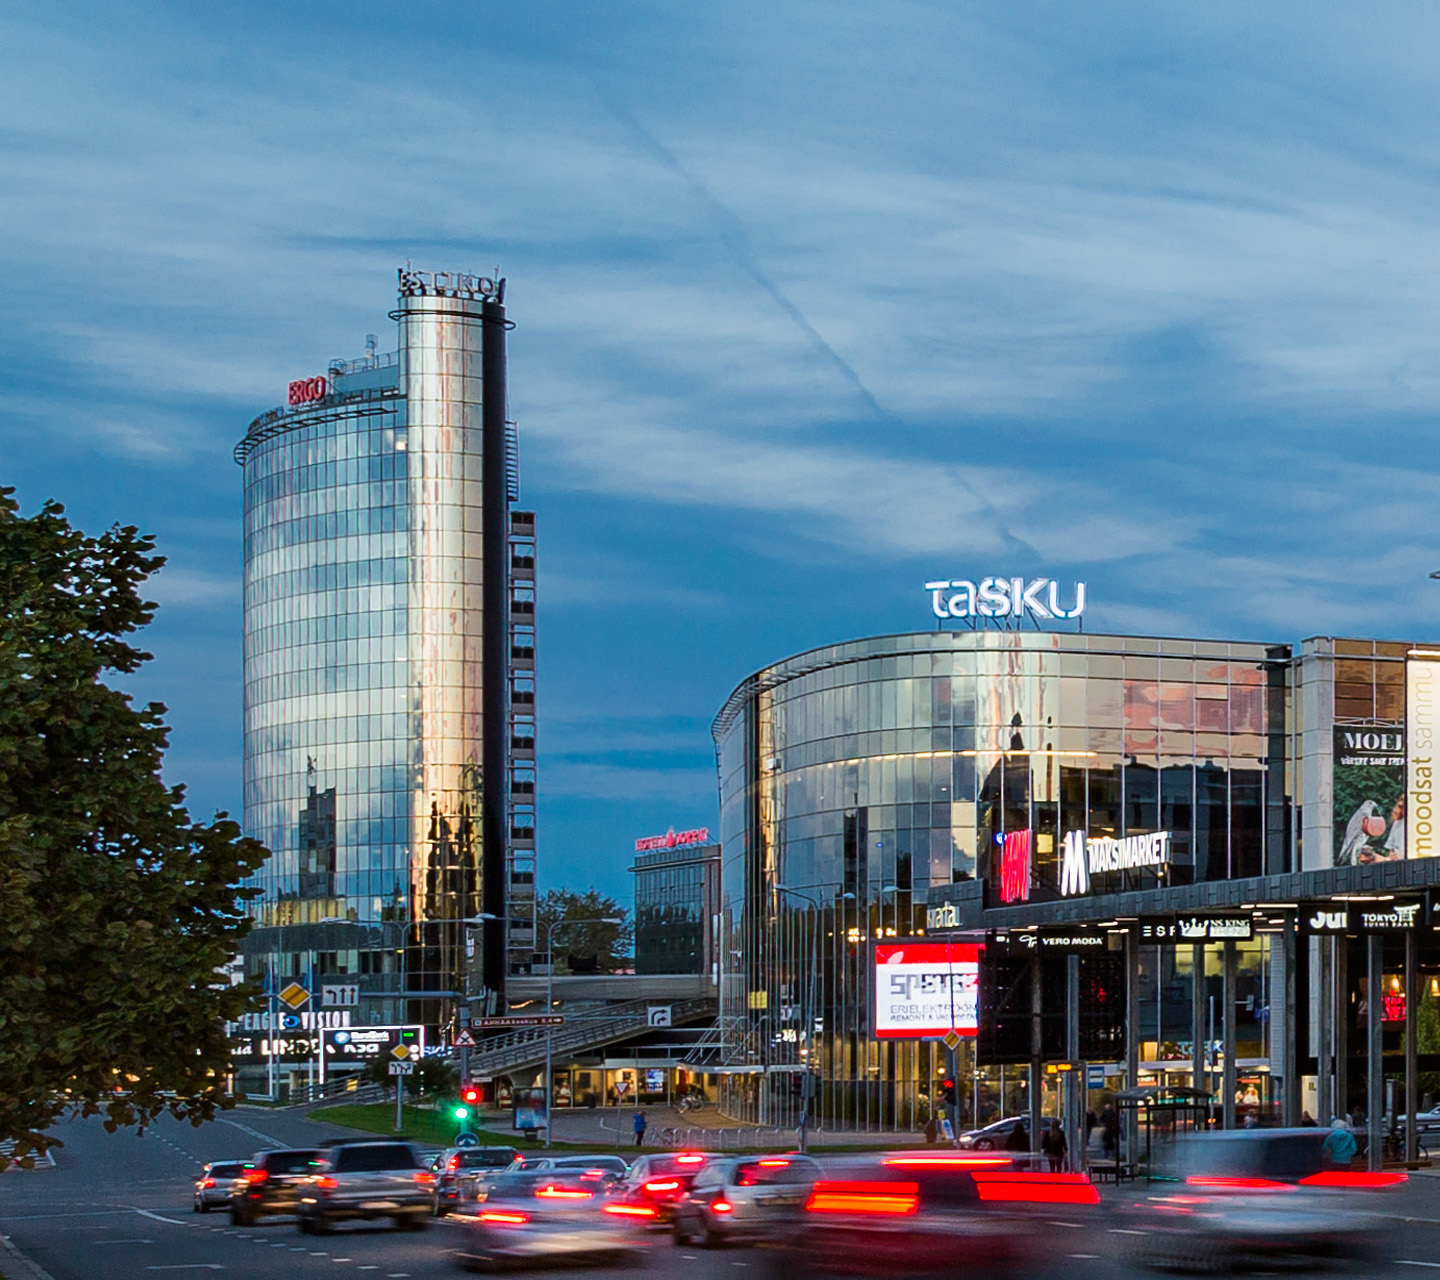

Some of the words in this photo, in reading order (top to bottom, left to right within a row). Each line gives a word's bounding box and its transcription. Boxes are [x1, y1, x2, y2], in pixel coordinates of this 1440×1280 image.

[400, 270, 496, 296] ESTIKO
[288, 376, 326, 405] ERGO
[1415, 666, 1433, 749] sammu
[1410, 756, 1433, 857] moodsat
[1089, 831, 1171, 873] MAKSIMARKET
[1362, 913, 1398, 922] TOKYO
[1043, 937, 1070, 946] VERO
[1072, 936, 1102, 945] MODA
[243, 1012, 286, 1030] EAGLE
[300, 1011, 350, 1030] VISION
